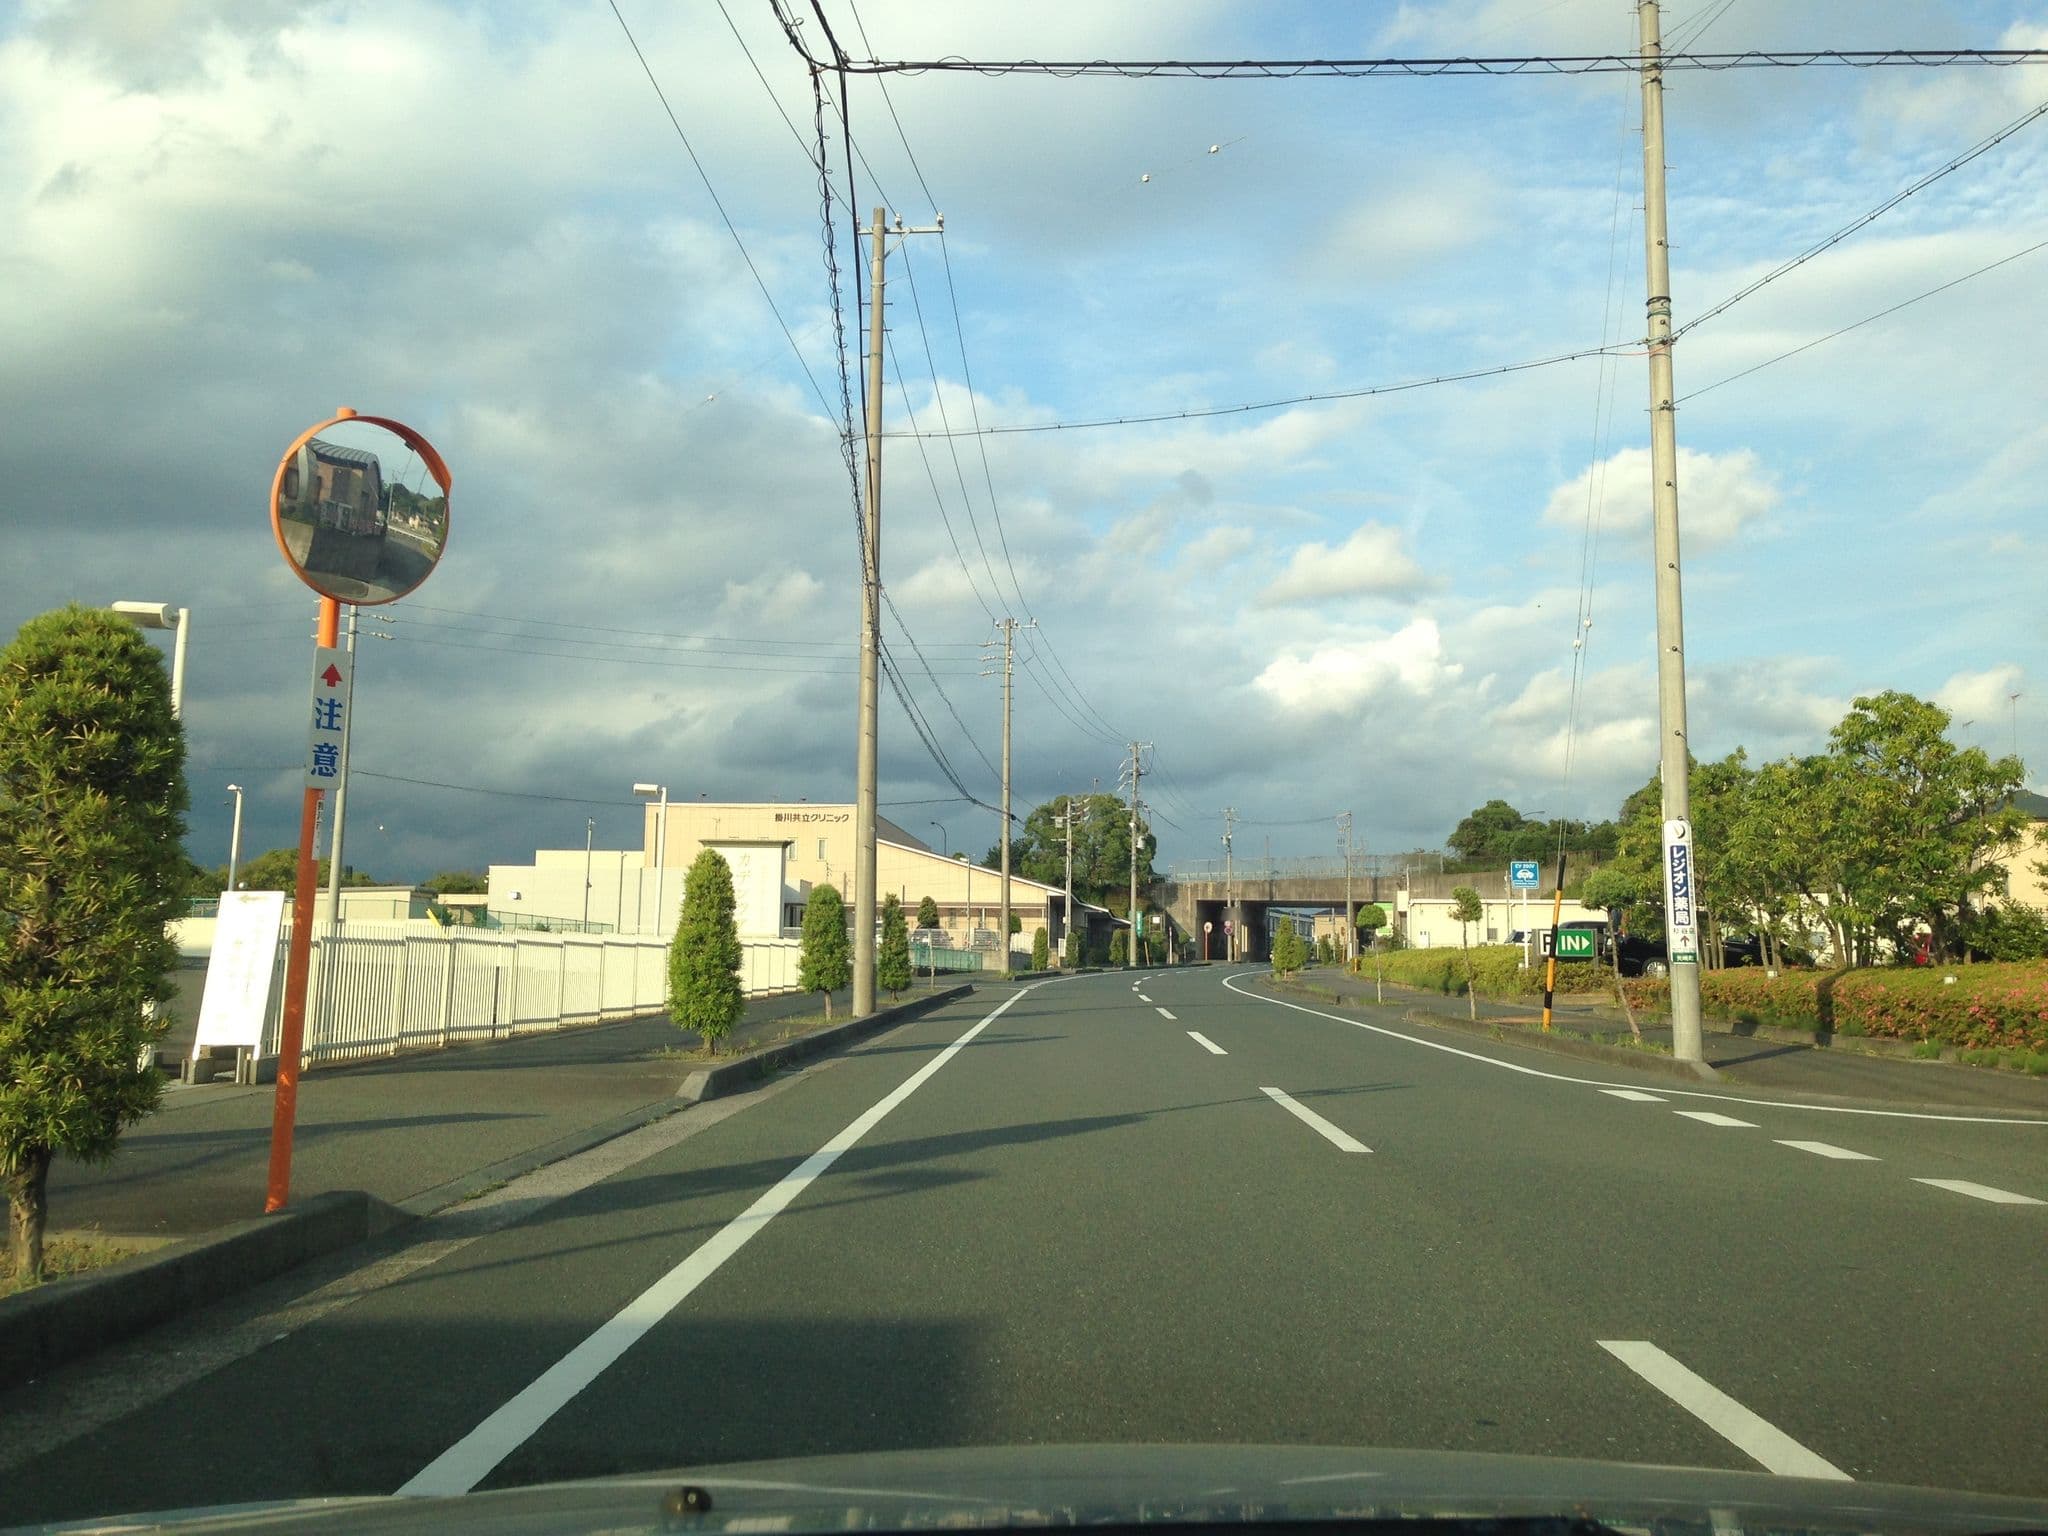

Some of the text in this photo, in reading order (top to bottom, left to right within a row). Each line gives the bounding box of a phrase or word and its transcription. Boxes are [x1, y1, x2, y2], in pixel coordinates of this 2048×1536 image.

[311, 698, 343, 777] 注意
[775, 813, 850, 823] 掛川共立クリニック
[1672, 847, 1690, 924] レジオン薬局
[1561, 935, 1580, 951] IN
